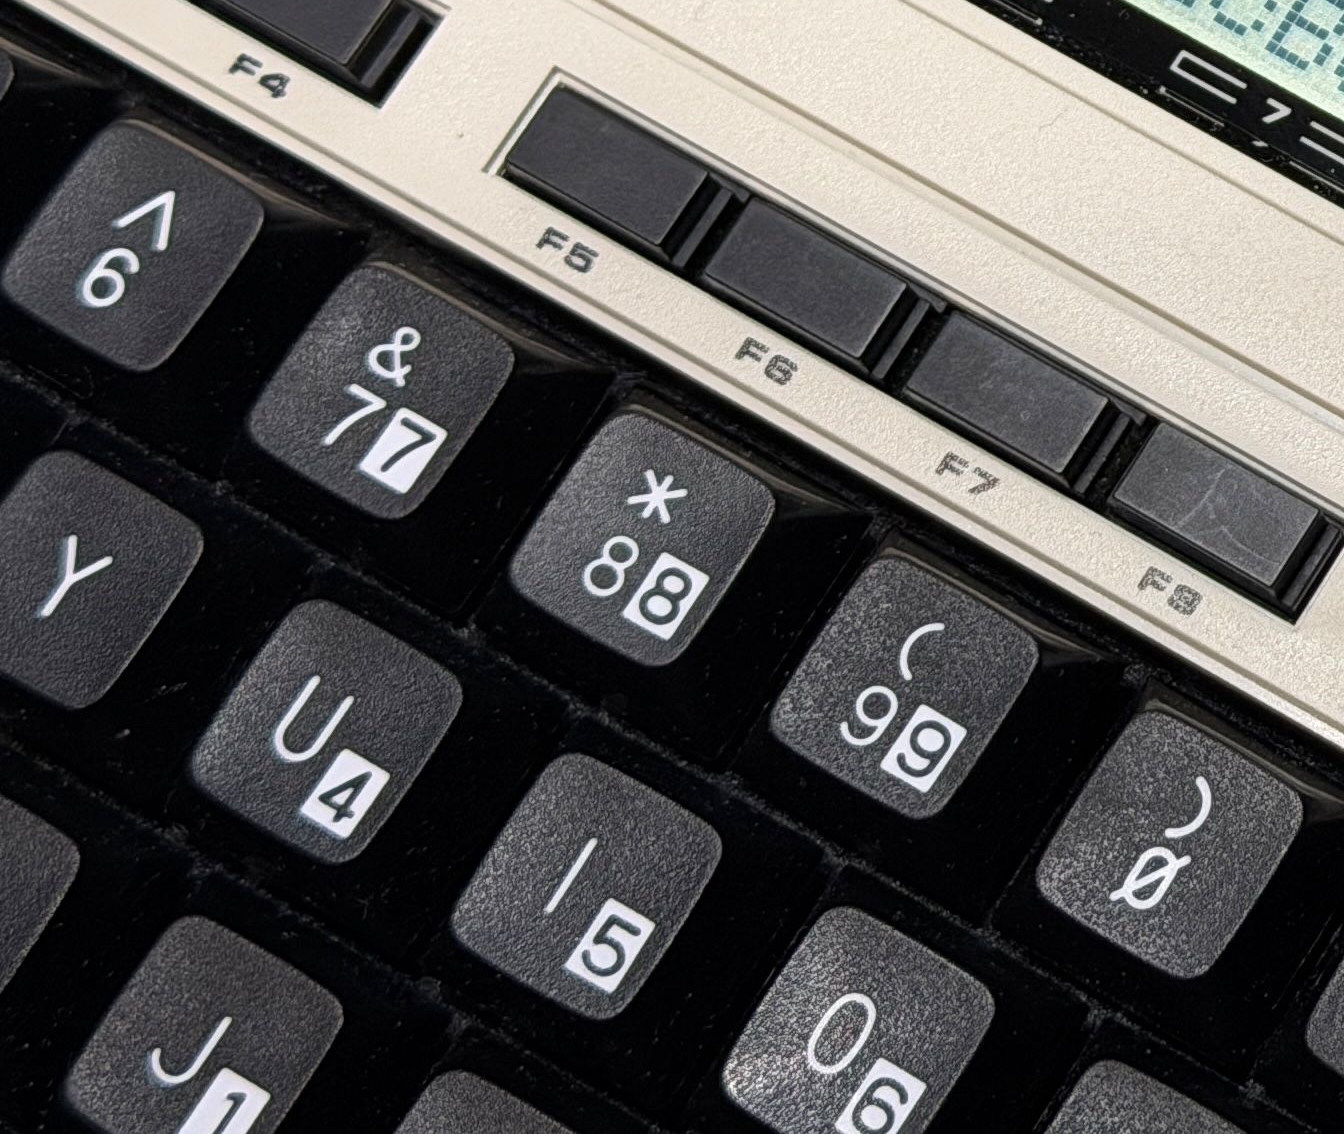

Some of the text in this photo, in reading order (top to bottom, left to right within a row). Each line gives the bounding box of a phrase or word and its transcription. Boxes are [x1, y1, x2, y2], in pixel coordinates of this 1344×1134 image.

[228, 53, 291, 99] F4
[1260, 97, 1293, 123] 7
[76, 247, 141, 308] 6
[534, 225, 600, 274] F5
[367, 326, 421, 387] &
[735, 336, 798, 385] F6
[322, 383, 388, 446] 7
[935, 451, 1000, 494] F7
[40, 534, 113, 618] Y
[583, 535, 693, 626] 8 8
[273, 674, 355, 763] U
[839, 685, 953, 778] 9 9
[581, 914, 643, 976] 5
[150, 1016, 233, 1086] J
